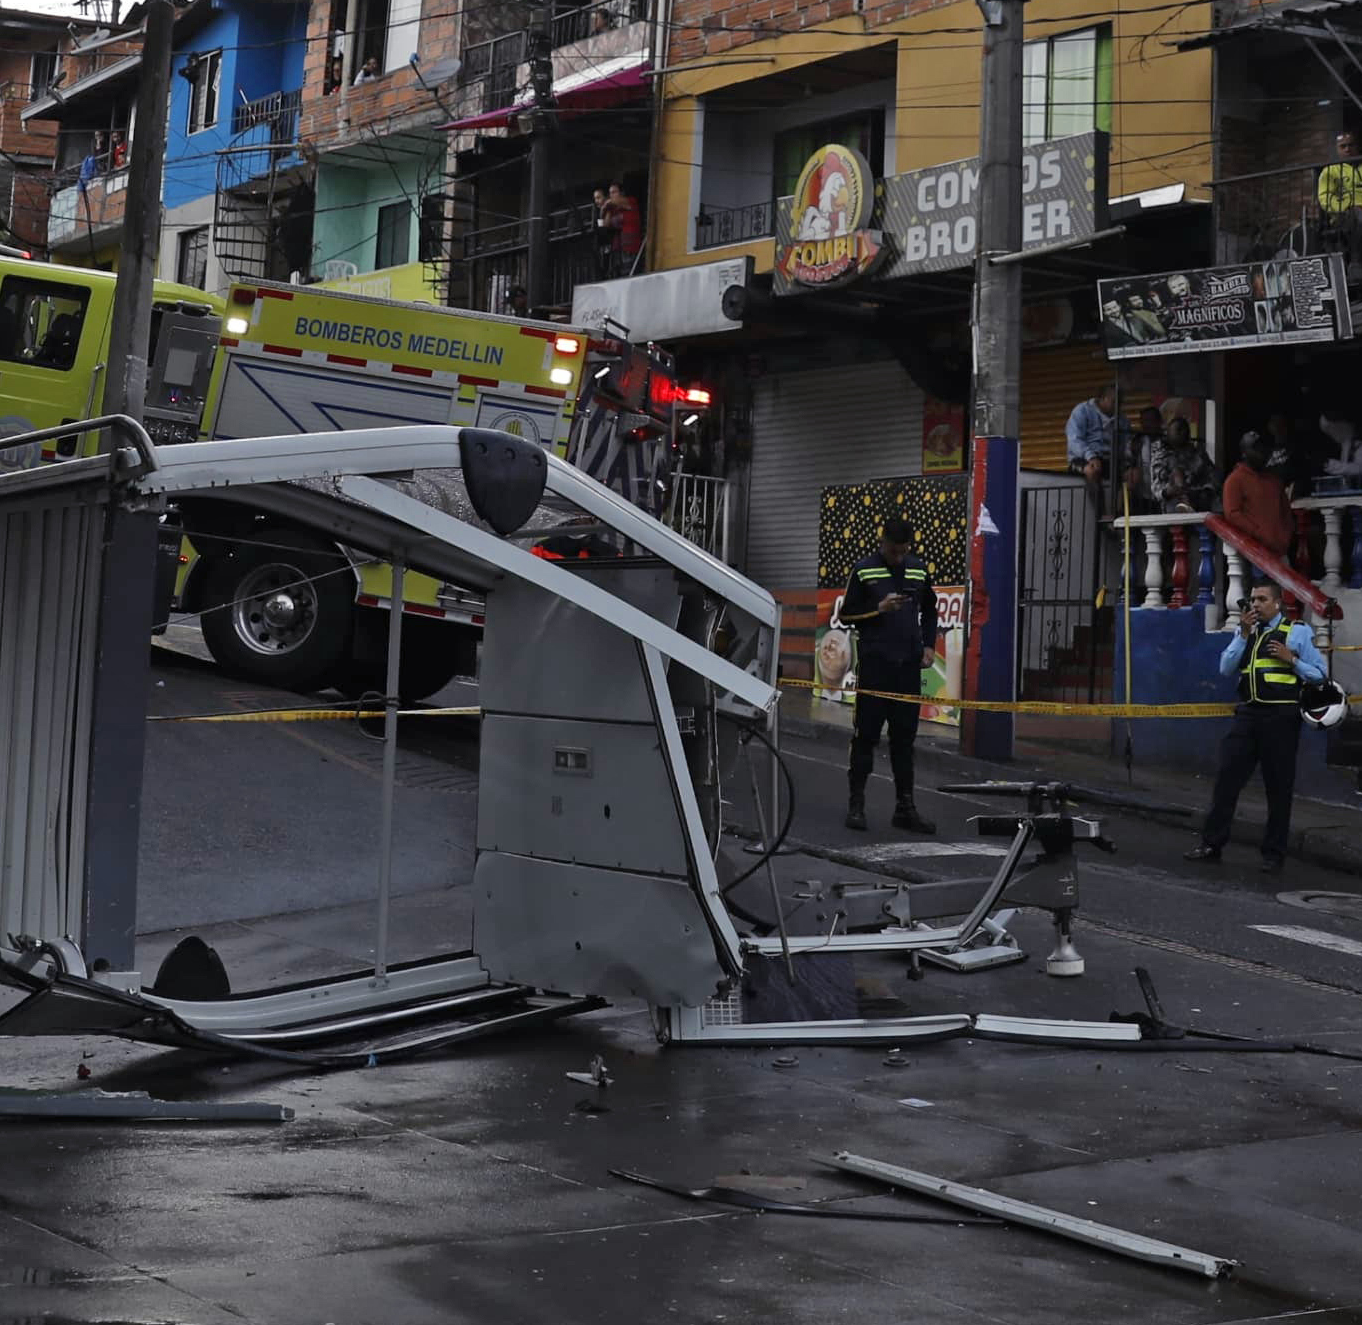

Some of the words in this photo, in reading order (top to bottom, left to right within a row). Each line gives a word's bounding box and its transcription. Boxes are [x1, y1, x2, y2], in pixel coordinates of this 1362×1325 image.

[917, 150, 1062, 212] COMOS
[906, 199, 1071, 262] BROER
[295, 317, 403, 350] BOMBEROS
[407, 333, 504, 366] MEDELLIN
